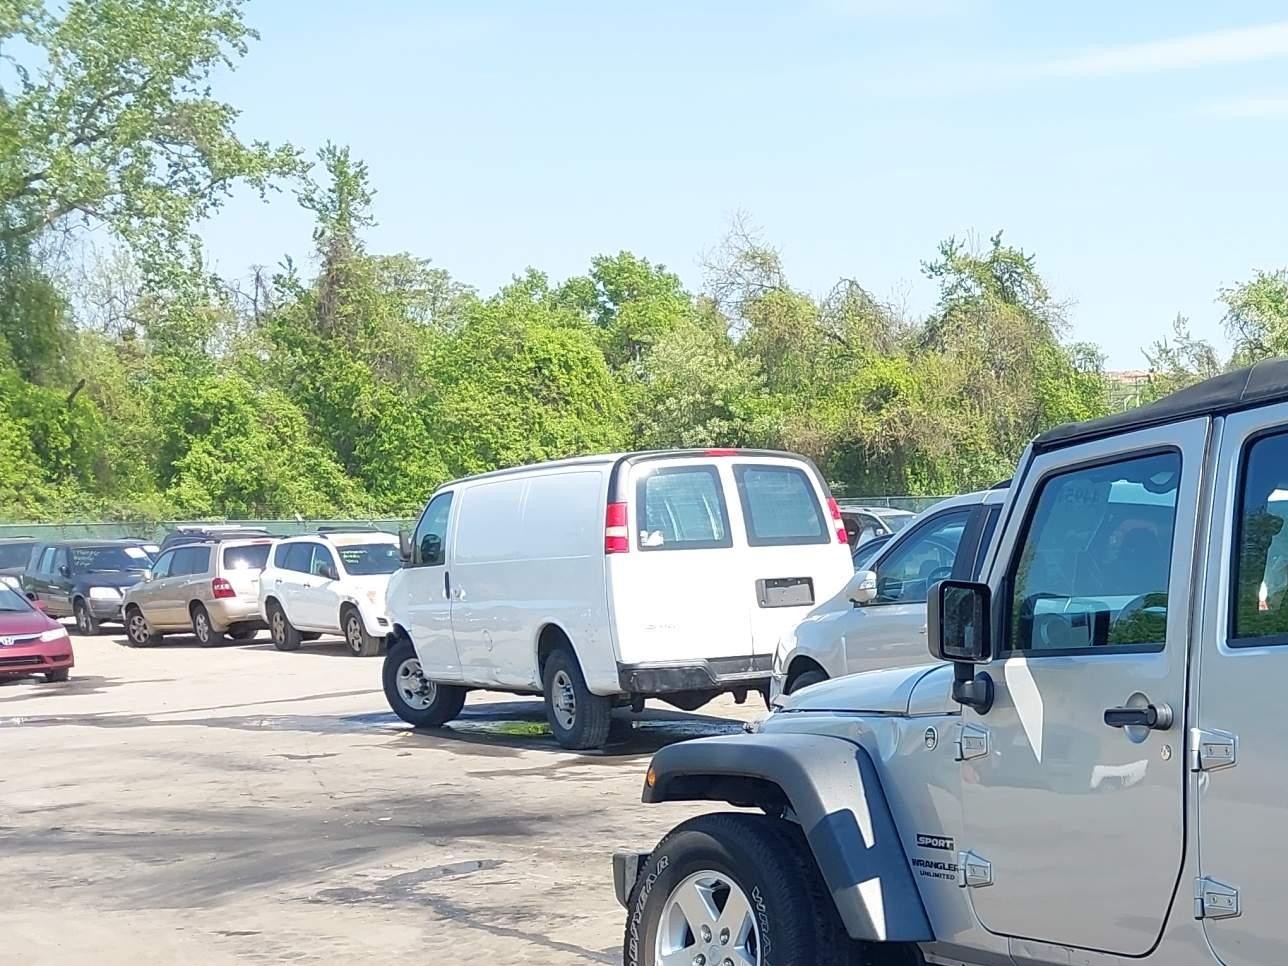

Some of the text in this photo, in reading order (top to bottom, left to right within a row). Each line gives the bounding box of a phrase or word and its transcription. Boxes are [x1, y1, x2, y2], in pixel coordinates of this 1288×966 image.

[918, 836, 954, 849] SPORT
[911, 858, 960, 873] WRANGLER
[919, 870, 956, 880] UNLIMITED
